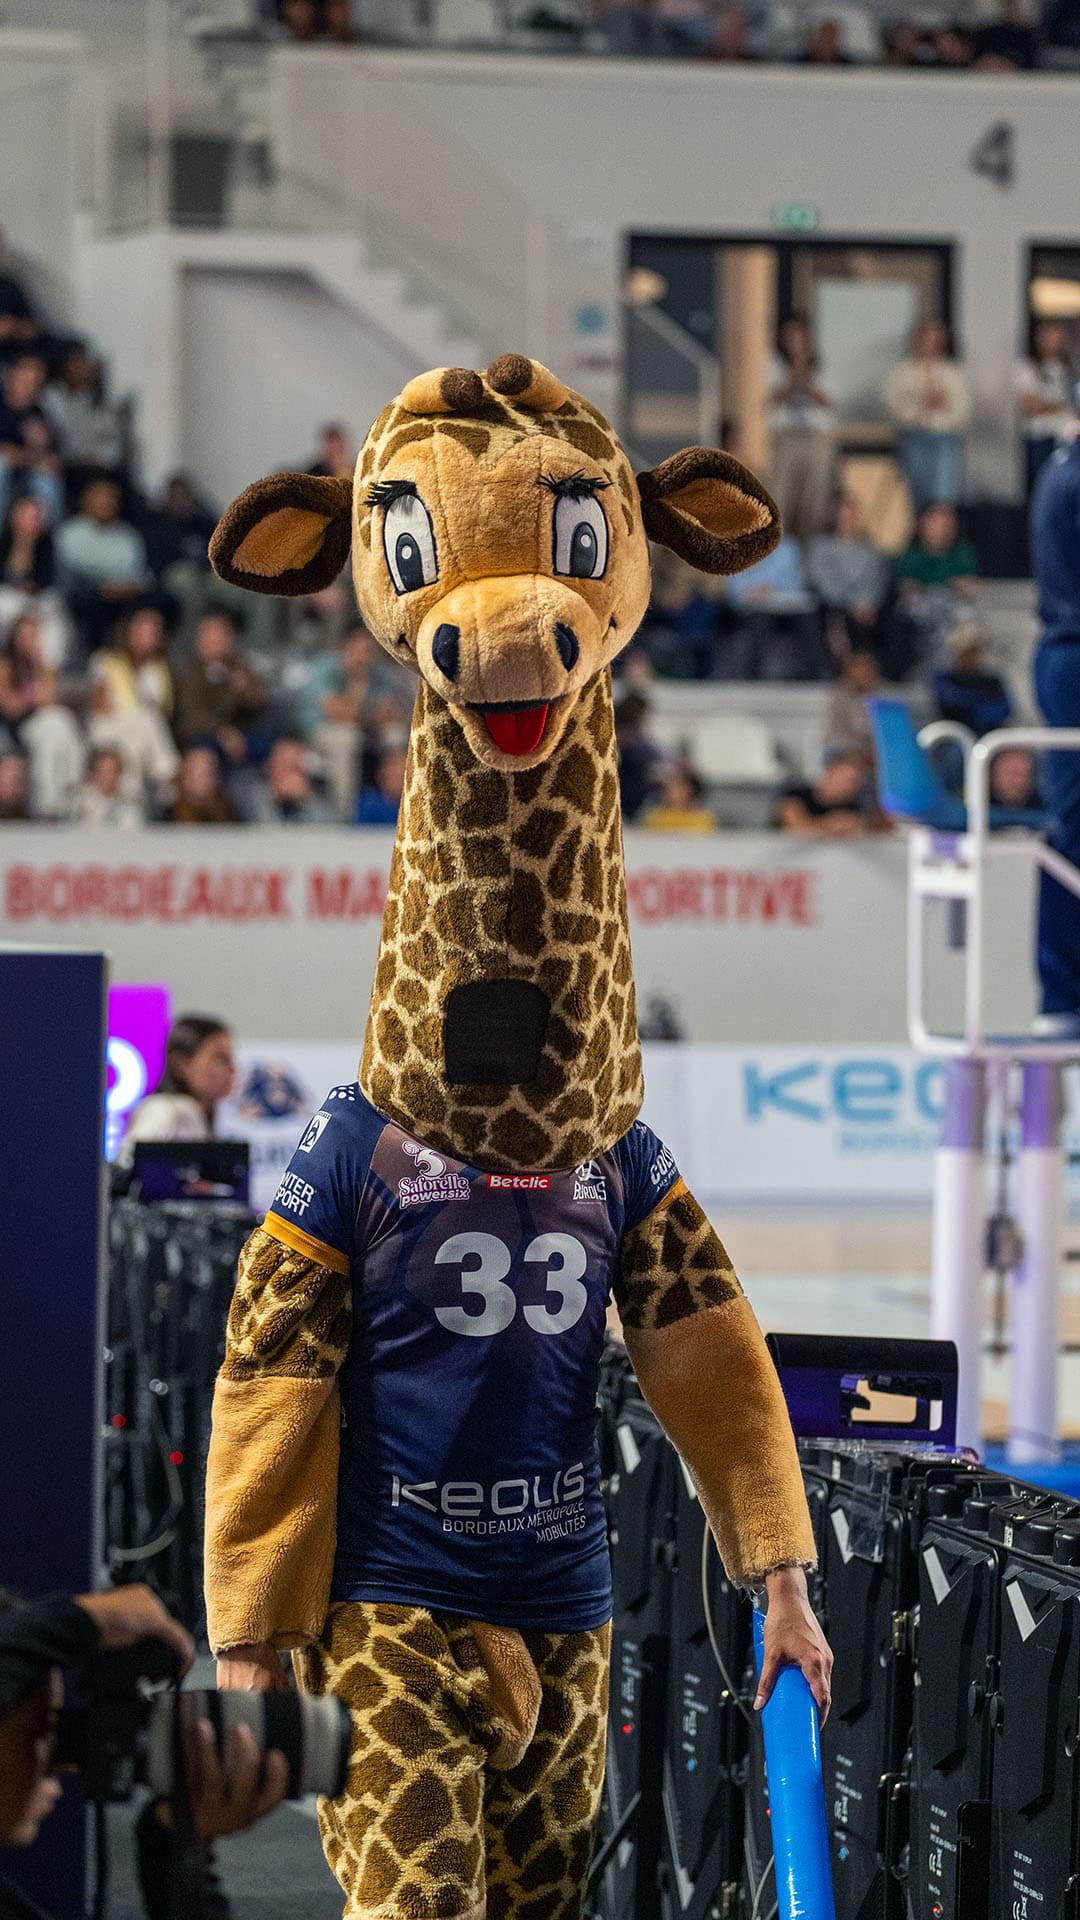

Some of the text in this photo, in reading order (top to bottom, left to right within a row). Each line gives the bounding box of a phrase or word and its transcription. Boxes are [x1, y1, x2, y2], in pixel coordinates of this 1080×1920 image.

[970, 120, 1017, 190] 4
[6, 865, 287, 921] BORDEAUX
[400, 1175, 468, 1196] Saforelle
[490, 1175, 549, 1188] Betclic
[434, 1231, 588, 1337] 33
[442, 1498, 585, 1535] BORDEAUX MÉTROPOLE
[536, 1515, 586, 1544] MOBILITÉS
